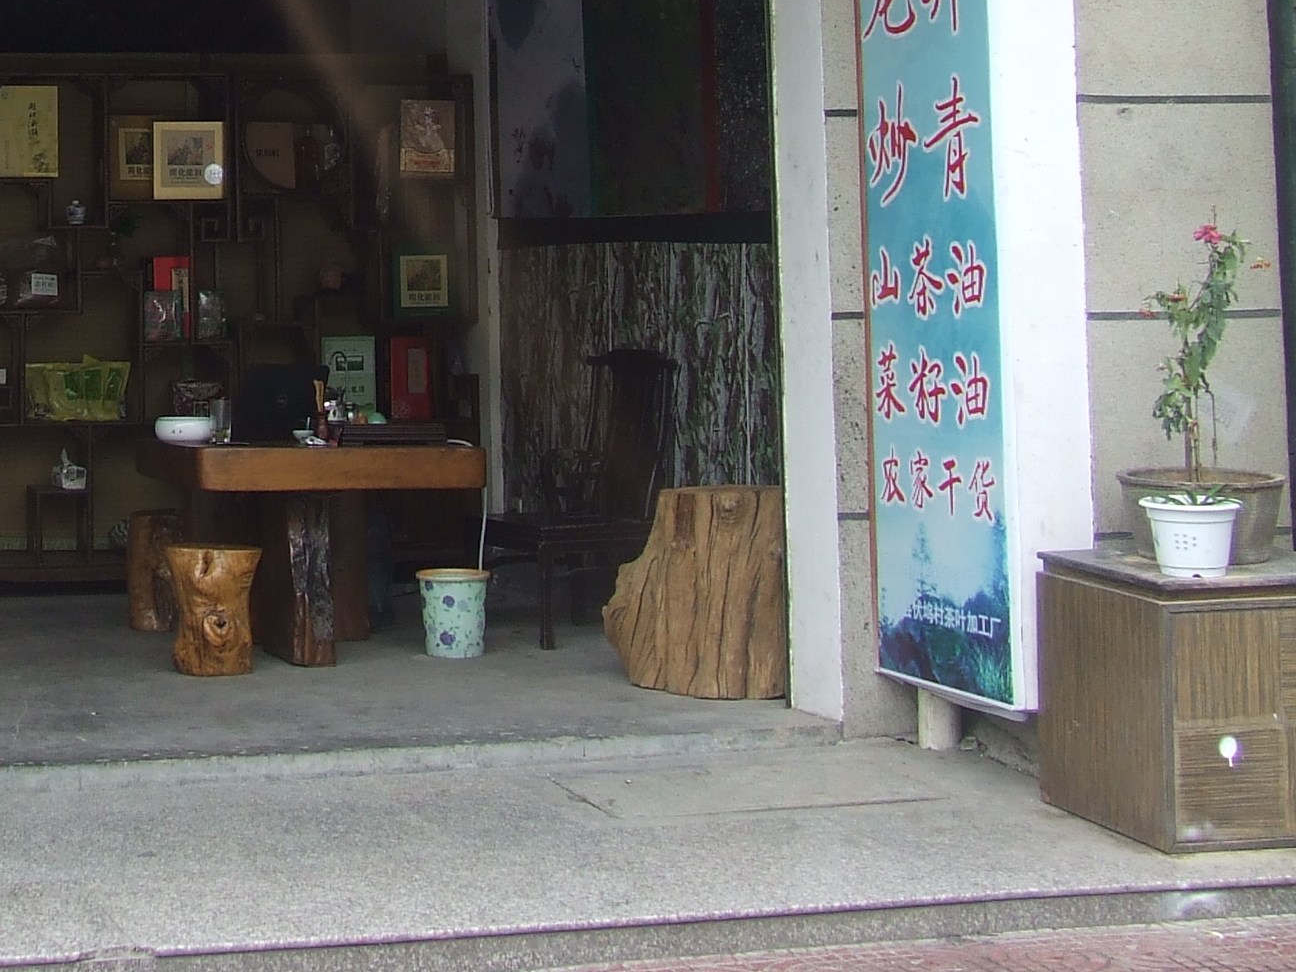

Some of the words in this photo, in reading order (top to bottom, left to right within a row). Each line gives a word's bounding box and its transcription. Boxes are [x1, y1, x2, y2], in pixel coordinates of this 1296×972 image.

[872, 235, 985, 319] 山茶油
[875, 341, 990, 428] 菜籽油
[880, 448, 996, 522] 农家干货
